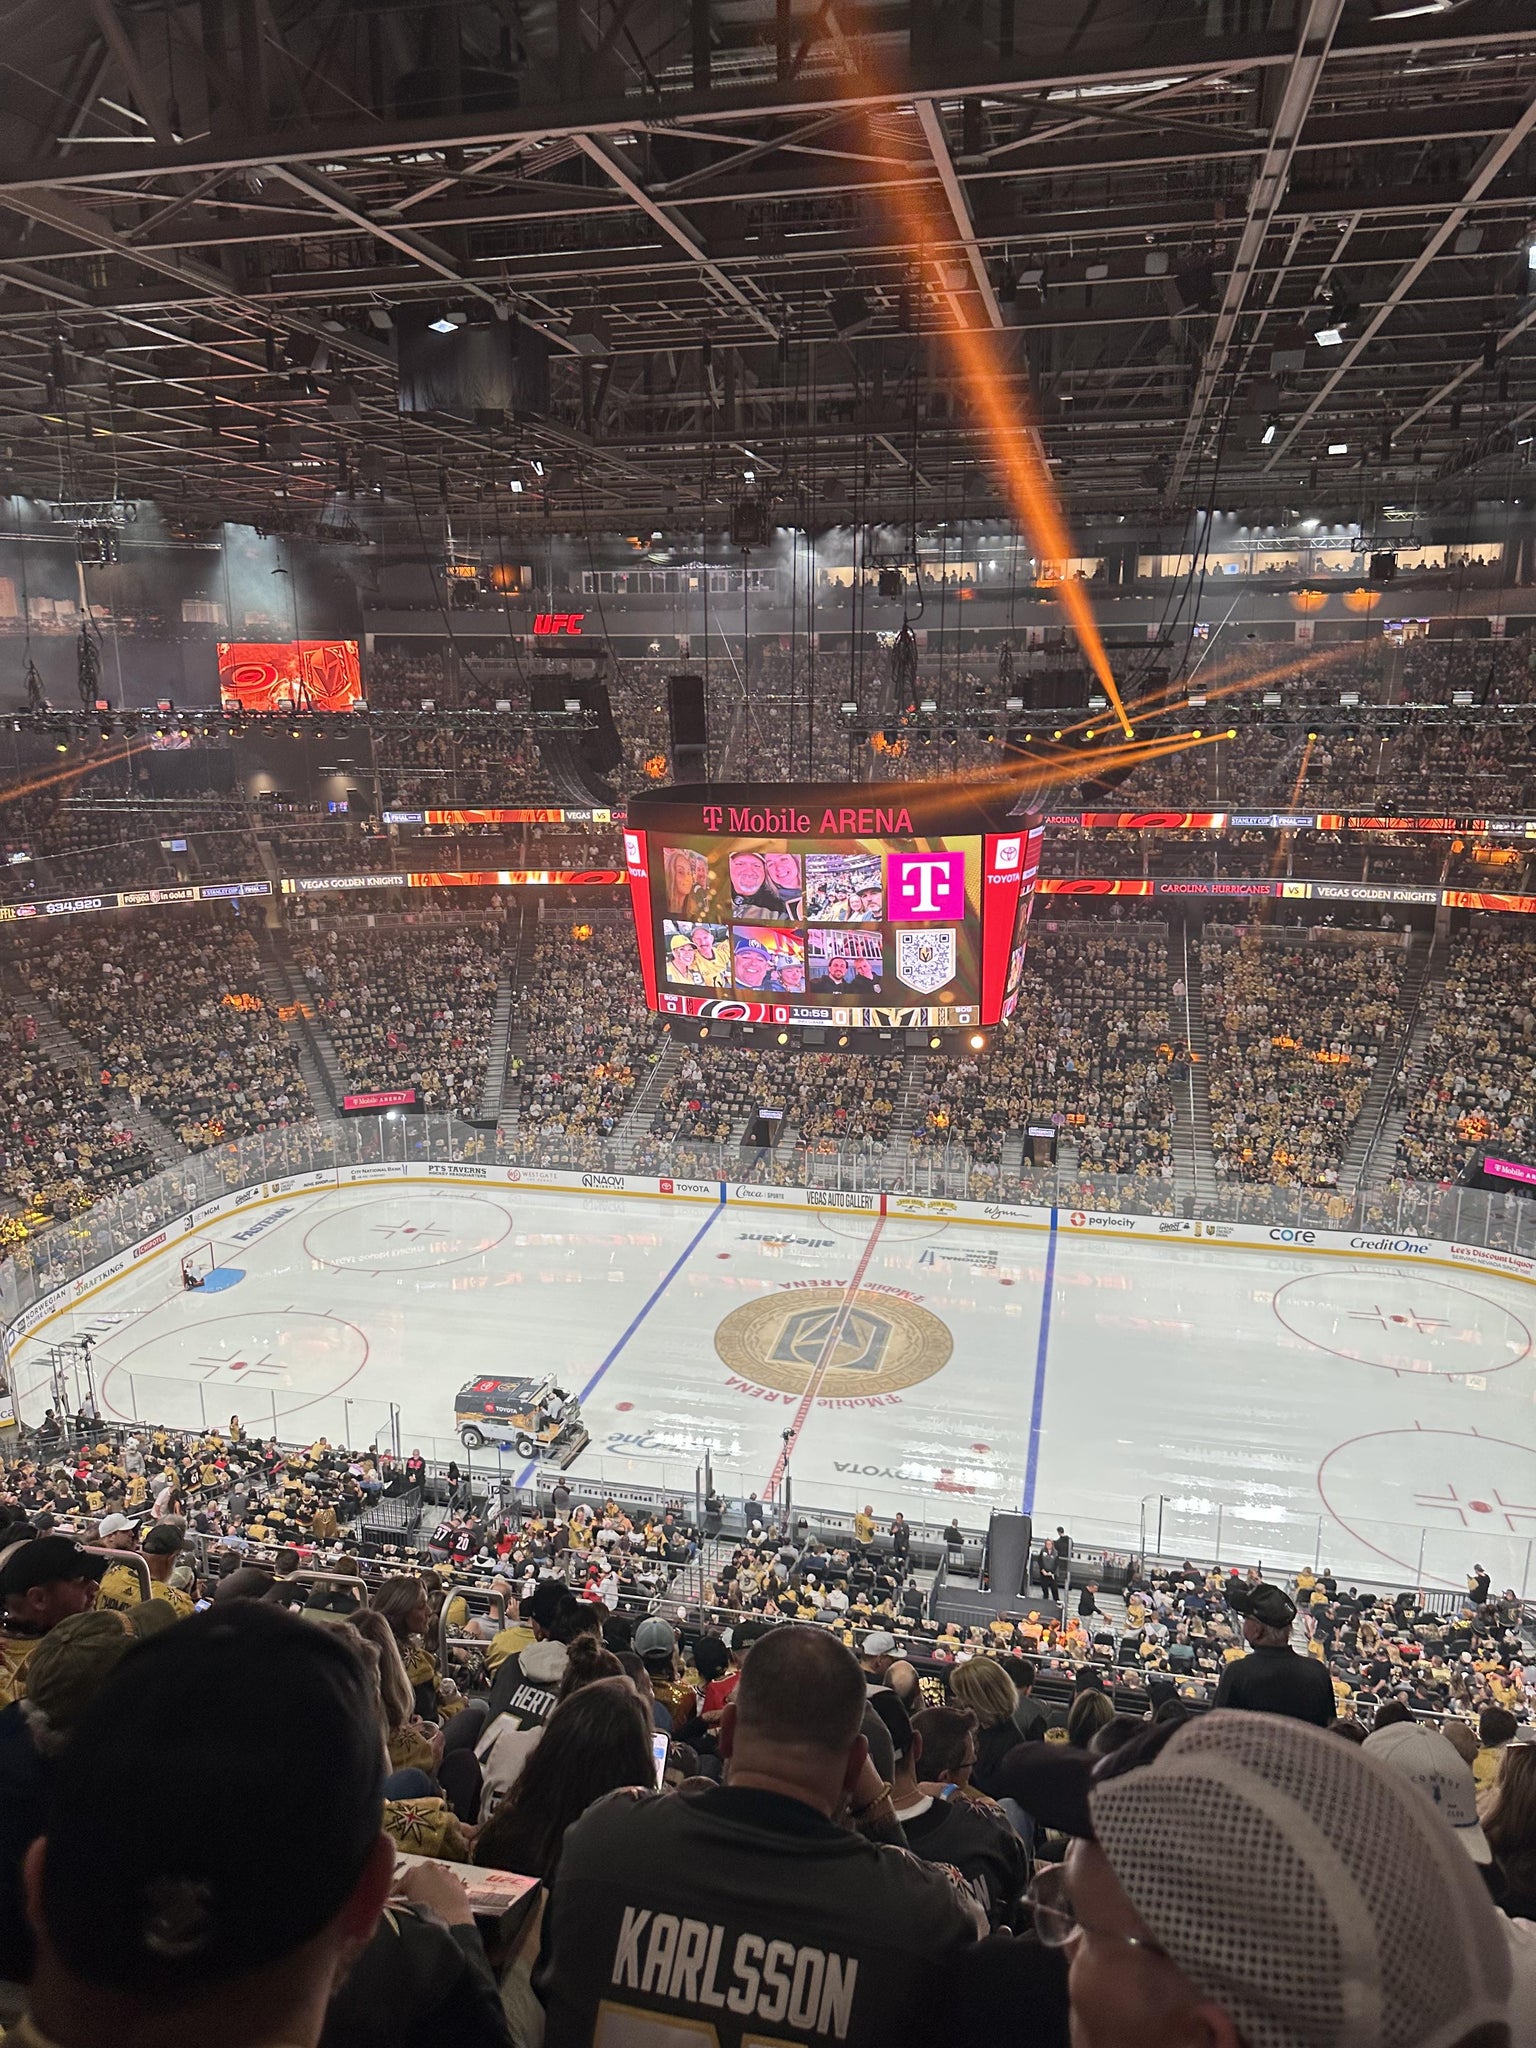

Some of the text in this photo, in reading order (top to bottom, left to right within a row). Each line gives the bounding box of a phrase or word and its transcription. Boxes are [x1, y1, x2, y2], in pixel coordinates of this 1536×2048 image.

[533, 613, 585, 635] UFC
[566, 811, 591, 820] VEGAS
[728, 807, 811, 833] Mobile
[819, 808, 914, 834] ARENA
[300, 876, 404, 890] VEGAS GOLDEN KNIGHTS
[987, 872, 1020, 885] TOYOTA
[1160, 884, 1271, 894] CAROLINA HURRICANES
[1287, 886, 1299, 895] VS
[1317, 886, 1437, 902] VEGAS GOLDEN KNIGHTS
[667, 1002, 677, 1011] 0
[793, 1008, 829, 1018] 10:59
[775, 1007, 787, 1022] 0
[835, 1011, 847, 1025] 0
[959, 1014, 970, 1024] 0
[448, 1165, 487, 1175] TAVERNS
[523, 1171, 558, 1179] WESTGATE
[1501, 1165, 1525, 1178] Mobile
[593, 1175, 625, 1187] NAQVI
[676, 1184, 710, 1193] TOYOTA
[735, 1185, 785, 1200] Circa SPORTS
[806, 1190, 874, 1210] VEGAS AUTO GALLERY
[194, 1204, 220, 1223] BETMGM
[232, 1206, 295, 1241] FASTENAL
[1089, 1216, 1136, 1230] paylocity
[139, 1232, 166, 1254] CHIPOTLE
[736, 1232, 836, 1248] allegiant
[1268, 1228, 1316, 1243] core
[1350, 1237, 1429, 1255] CreditOne
[939, 1255, 997, 1265] NATIONAL
[1450, 1246, 1535, 1269] Lee's Discount Liquor
[1452, 1254, 1477, 1263] SERVING
[1477, 1259, 1502, 1269] NEVADA
[1502, 1264, 1519, 1273] SINCE
[75, 1262, 124, 1296] DRAFTKINGS
[778, 1279, 848, 1290] ARENA
[863, 1281, 913, 1300] Mobile
[25, 1289, 67, 1322] NORWEGIAN
[26, 1311, 43, 1328] CRUISE
[723, 1376, 799, 1406] ARENA
[495, 1406, 518, 1414] TOYOTA
[818, 1395, 892, 1410] Mobile
[434, 1527, 449, 1541] 37
[456, 1537, 470, 1551] 20
[611, 1905, 859, 2040] KARLSSON
